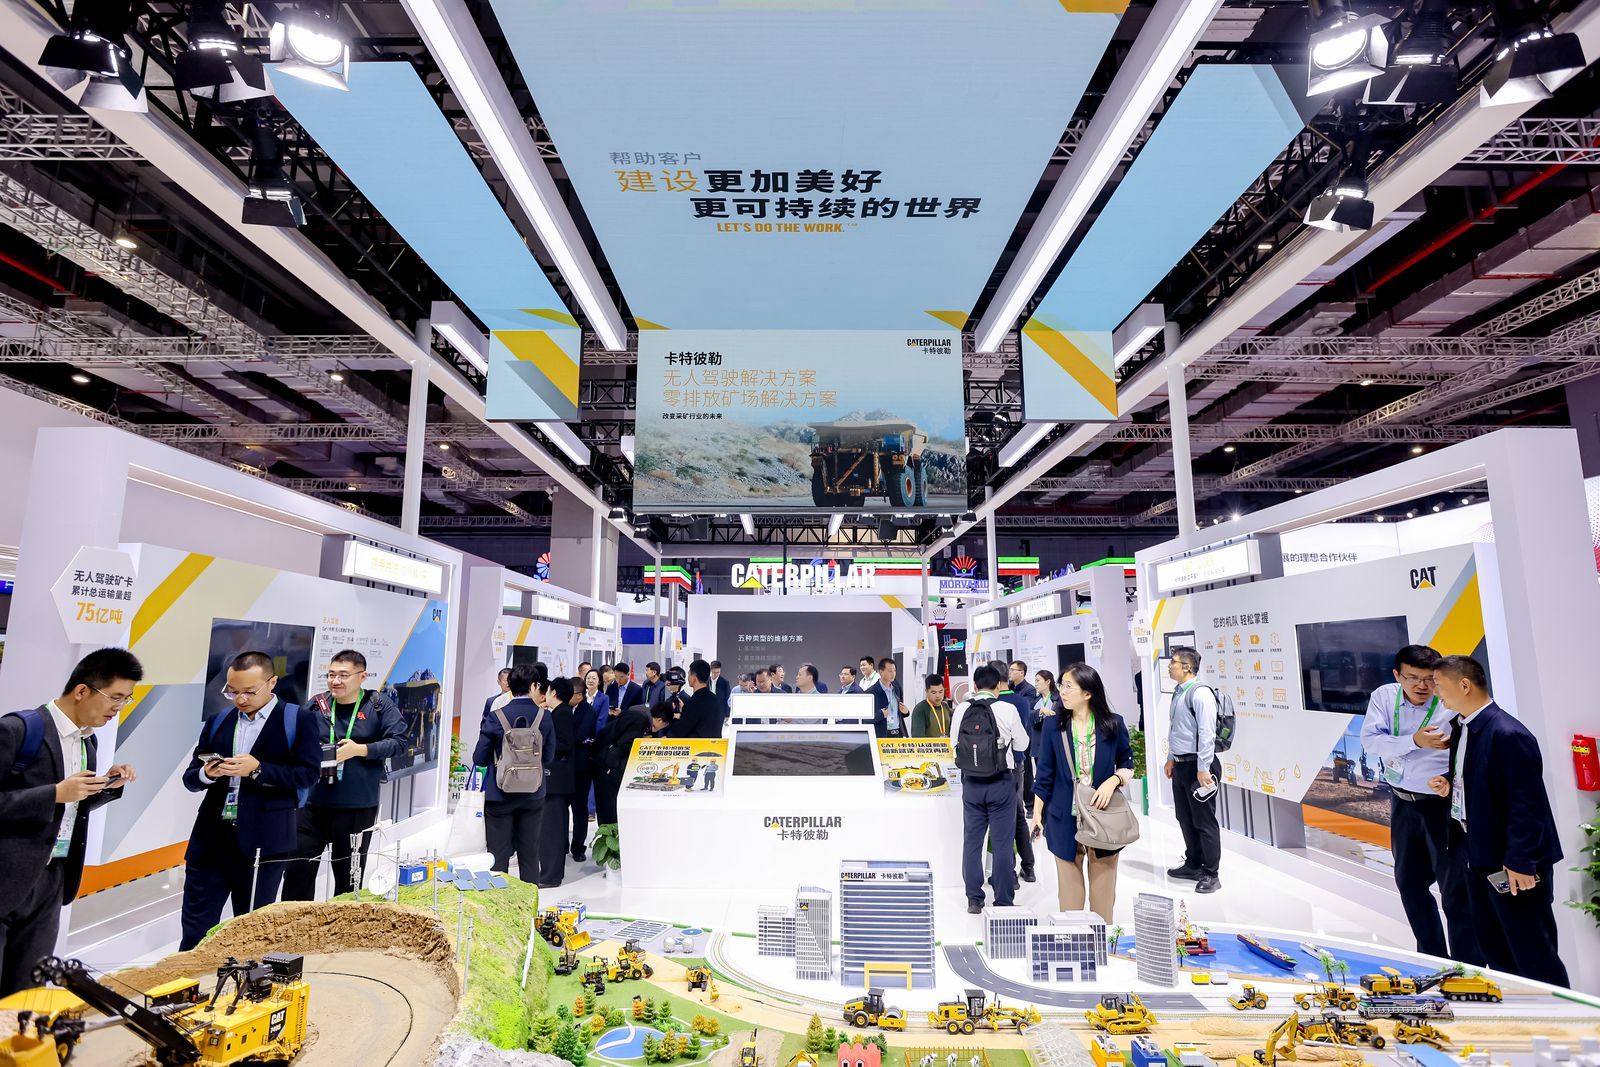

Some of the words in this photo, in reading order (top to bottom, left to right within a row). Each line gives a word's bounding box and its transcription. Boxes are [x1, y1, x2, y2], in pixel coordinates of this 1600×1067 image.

[609, 152, 701, 165] 帮助客户
[614, 169, 882, 193] 建设更加美好
[690, 197, 982, 219] 更可持续的世界
[716, 223, 752, 233] LET'S
[755, 223, 773, 233] DO
[776, 223, 800, 233] THE
[906, 338, 952, 347] CATERPILLAR
[921, 346, 952, 355] 卡特彼勒
[664, 351, 722, 366] 卡特彼勒
[663, 368, 817, 387] 无人驾驶解决方案
[663, 389, 837, 408] 零排放矿场解决方案
[662, 412, 723, 420] 改变采矿行业的未来
[73, 570, 134, 588] 无人驾驶矿卡
[731, 563, 876, 589] CATERPILLAR
[1409, 565, 1437, 590] CAT
[71, 585, 132, 601] 累计总运输量超
[76, 602, 123, 625] 75亿吨
[1212, 616, 1239, 629] 您的机队
[1240, 611, 1270, 626] 轻松掌握
[738, 634, 803, 642] 五种类型的维修方案
[763, 816, 842, 828] CATERPILLAR
[777, 829, 829, 841] 卡特彼勒
[840, 872, 877, 880] CATERPILLAR
[271, 1010, 286, 1024] CAT
